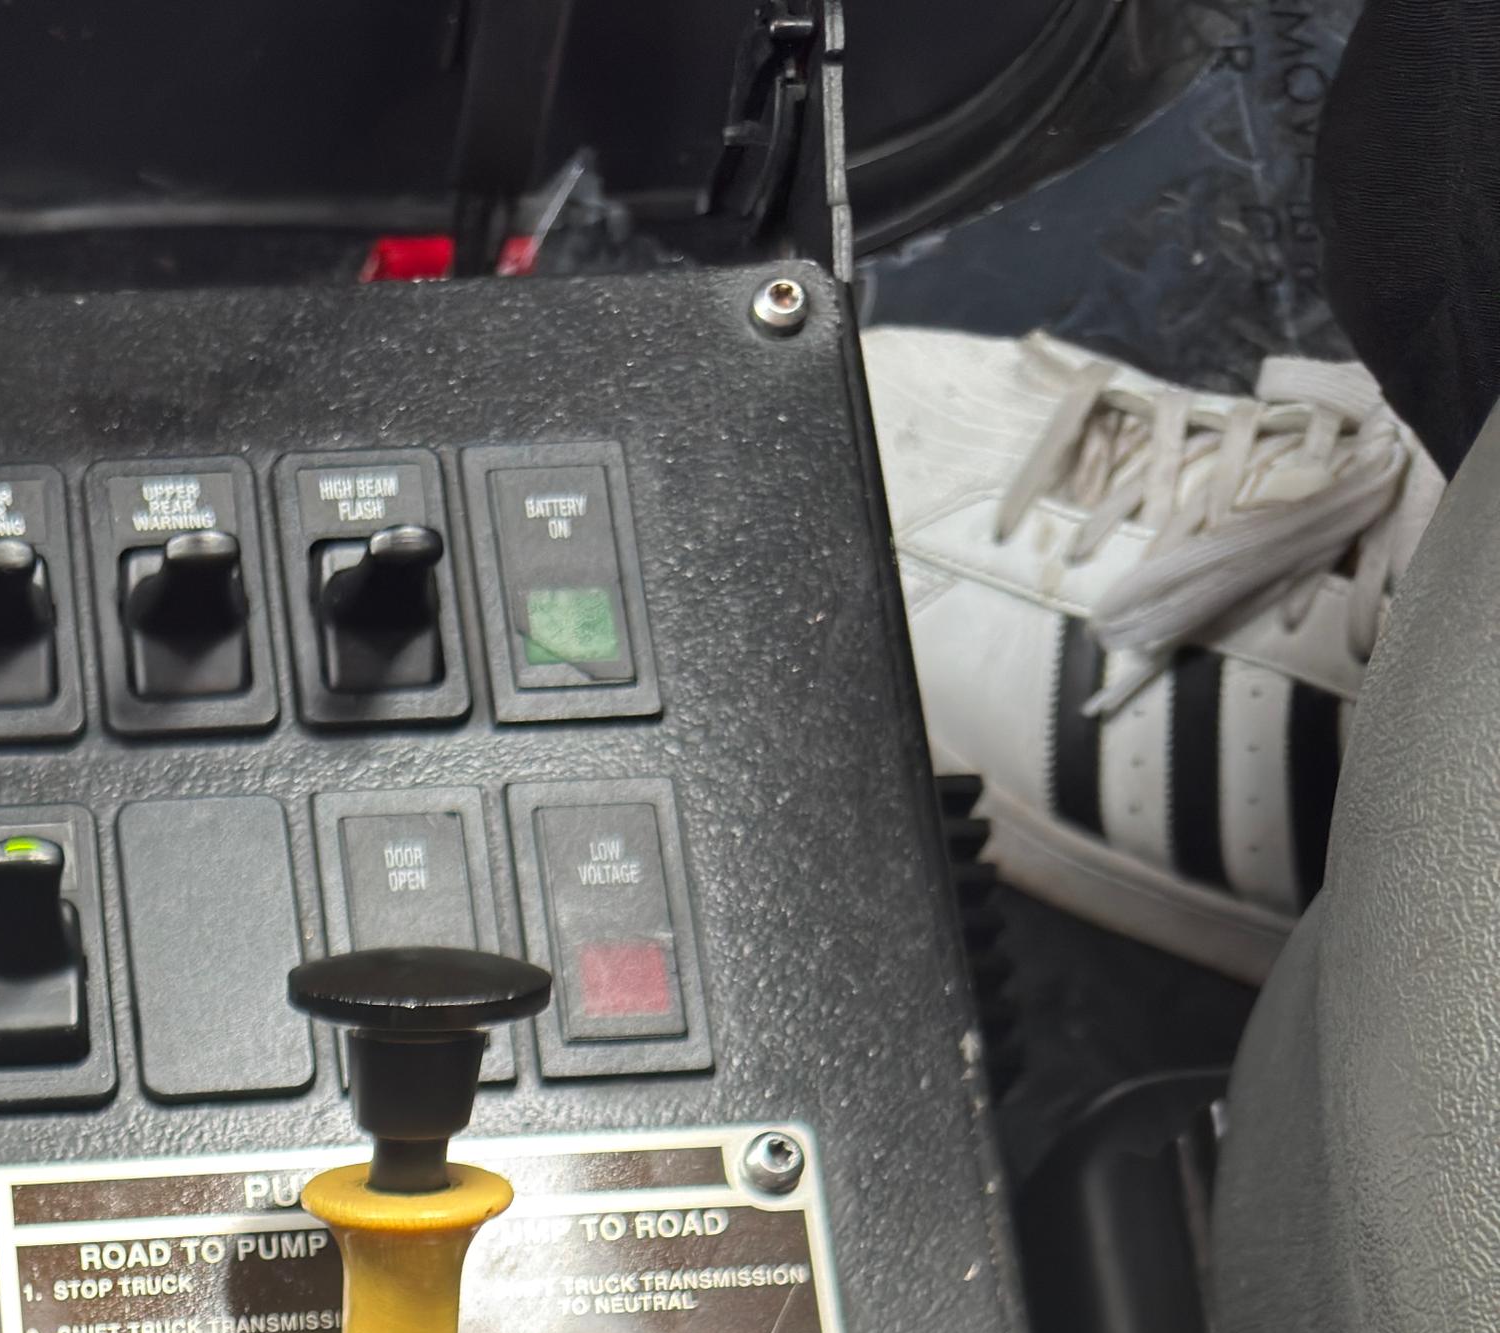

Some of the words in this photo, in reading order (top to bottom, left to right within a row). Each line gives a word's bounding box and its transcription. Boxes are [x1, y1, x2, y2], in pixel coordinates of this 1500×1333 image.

[142, 476, 200, 502] UPPER
[319, 475, 352, 500] HIGH
[355, 473, 398, 498] BEAM
[149, 499, 195, 515] REAR
[338, 499, 385, 521] FLASH
[525, 495, 587, 518] BATTERY
[133, 510, 216, 532] WARNING
[548, 518, 571, 540] ON
[384, 841, 424, 868] DOOR
[589, 838, 621, 862] LOW
[388, 866, 427, 891] OPEN
[577, 861, 640, 886] VOLTAGE
[578, 1213, 626, 1242] TO
[636, 1208, 730, 1239] ROAD
[80, 1242, 172, 1271] ROAD
[180, 1236, 226, 1265] TO
[237, 1231, 328, 1261] PUMP
[24, 1284, 42, 1302] 1.
[53, 1277, 113, 1301] STOP
[117, 1273, 195, 1296] TRUCK
[560, 1271, 637, 1296] TRUCK
[639, 1264, 810, 1292] TRANSMISSION
[560, 1294, 591, 1316] TO
[594, 1291, 699, 1315] NEUTRAL
